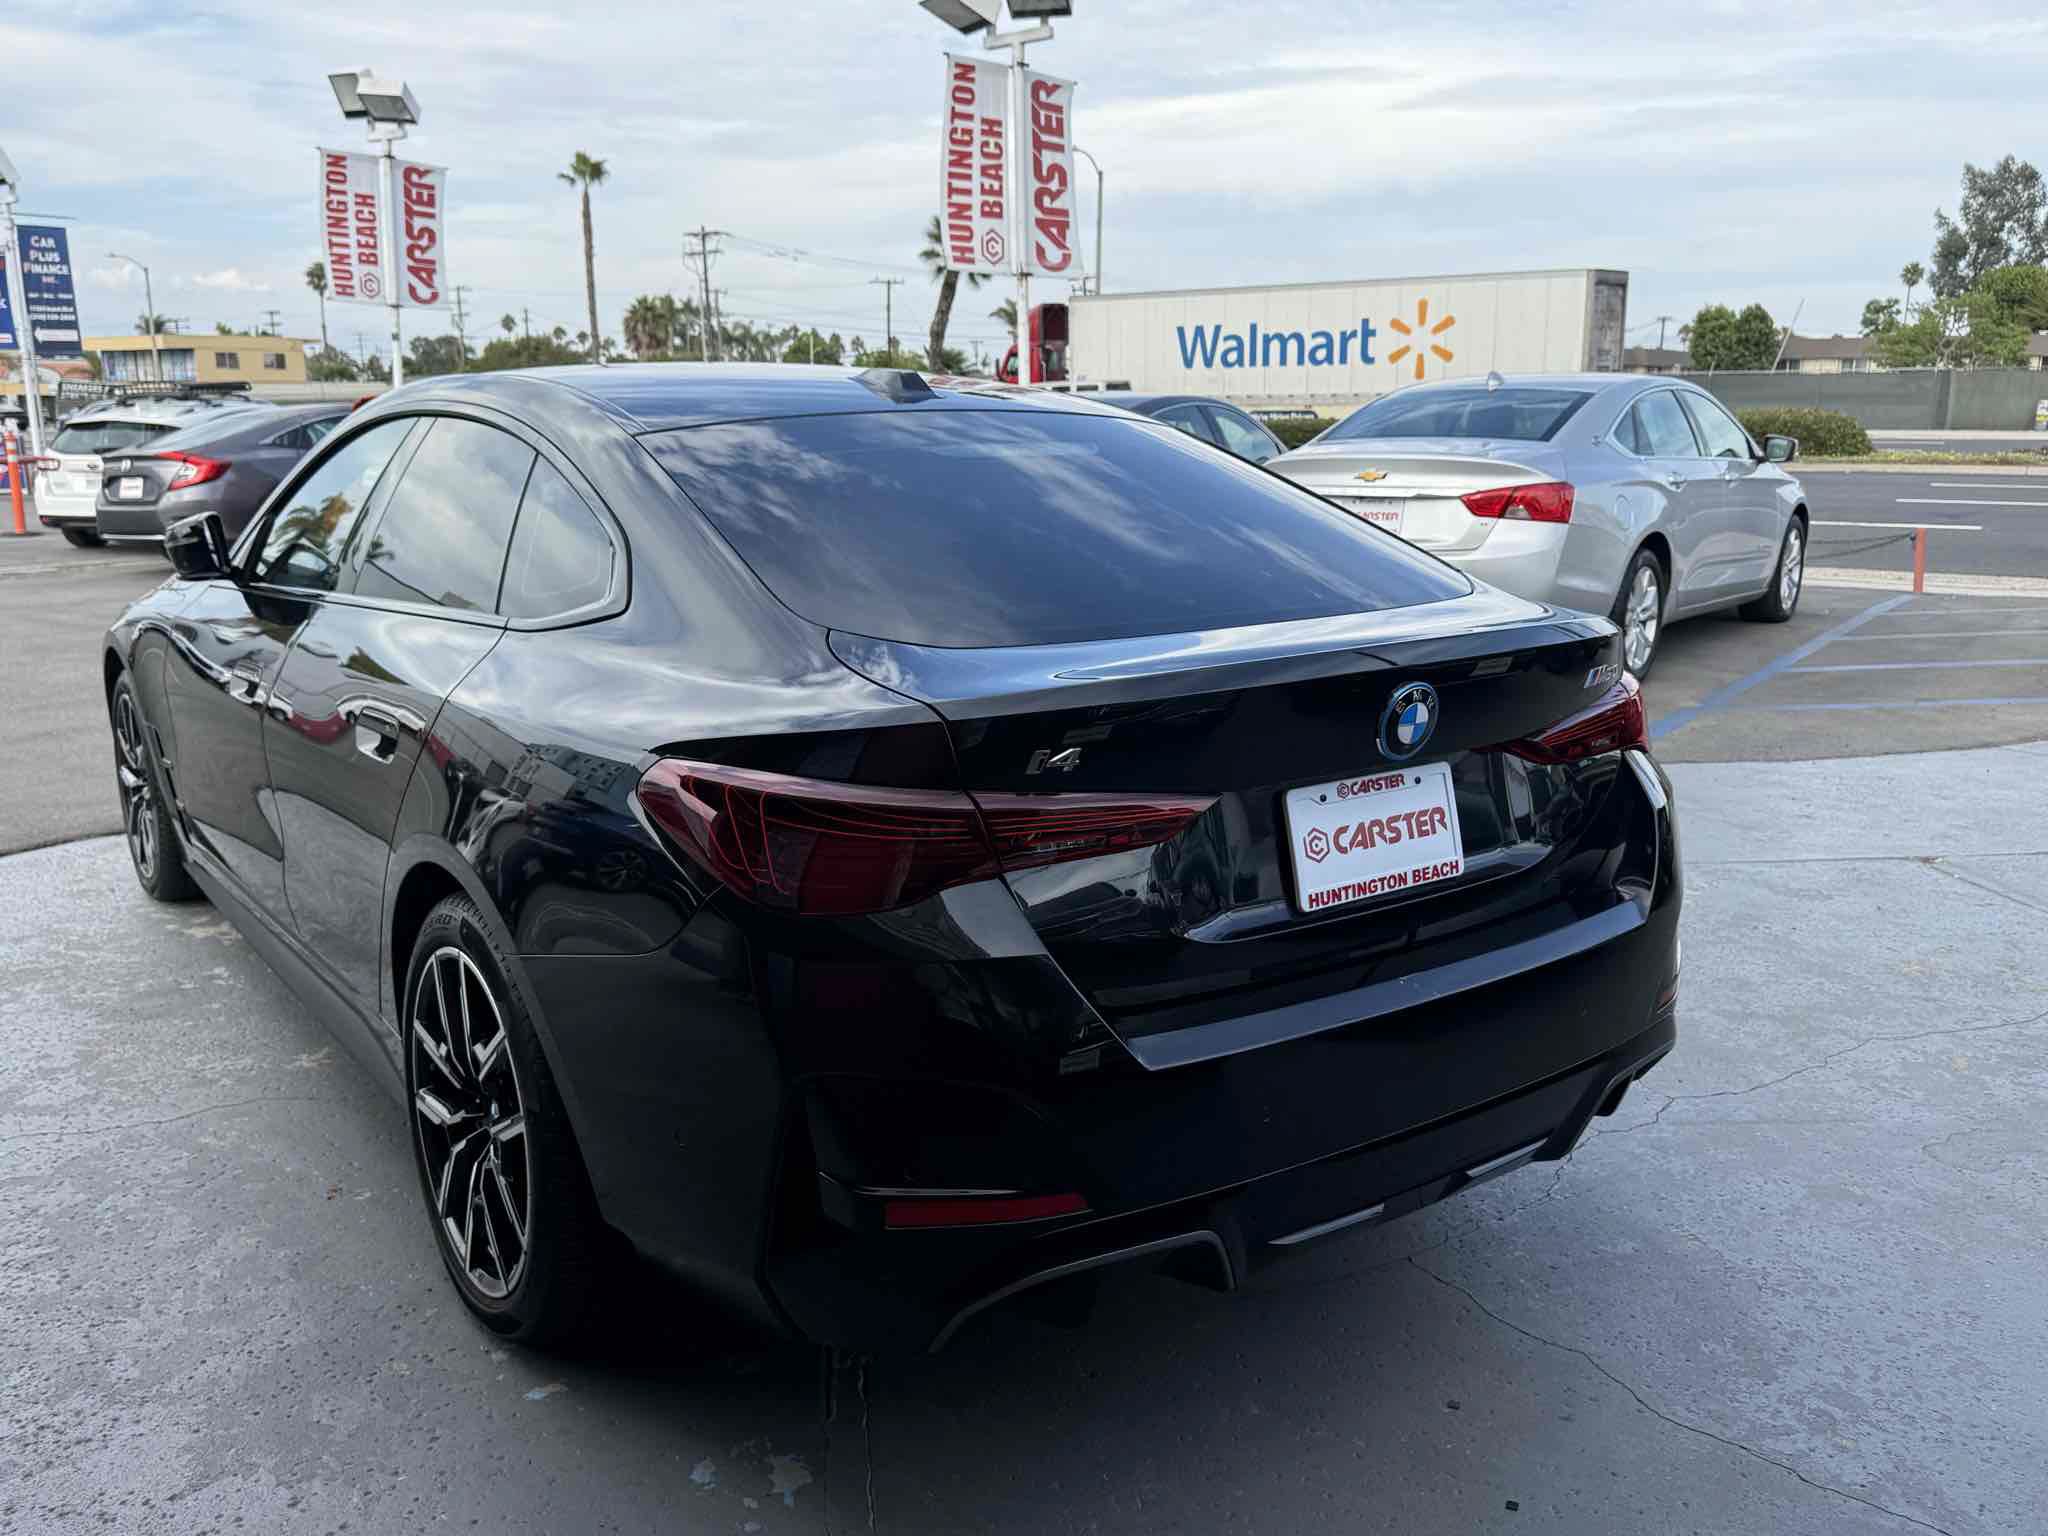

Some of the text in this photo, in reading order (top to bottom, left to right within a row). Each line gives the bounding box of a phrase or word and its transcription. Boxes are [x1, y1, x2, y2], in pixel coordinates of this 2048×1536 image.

[947, 62, 976, 264] HUNTINGTON
[980, 116, 1003, 219] BEACH
[1031, 79, 1072, 272] CARSTER
[30, 235, 56, 248] CAR
[325, 153, 355, 296] HUNTINGTON
[354, 192, 378, 266] BEACH
[403, 165, 440, 305] CARSTER
[23, 262, 70, 275] FINANCE
[29, 250, 61, 263] PLUS
[1176, 318, 1377, 369] Walmart
[1349, 773, 1406, 796] CARSTER
[1333, 806, 1448, 855] CARSTER
[1307, 859, 1460, 909] HUNTINGTON BEACH
